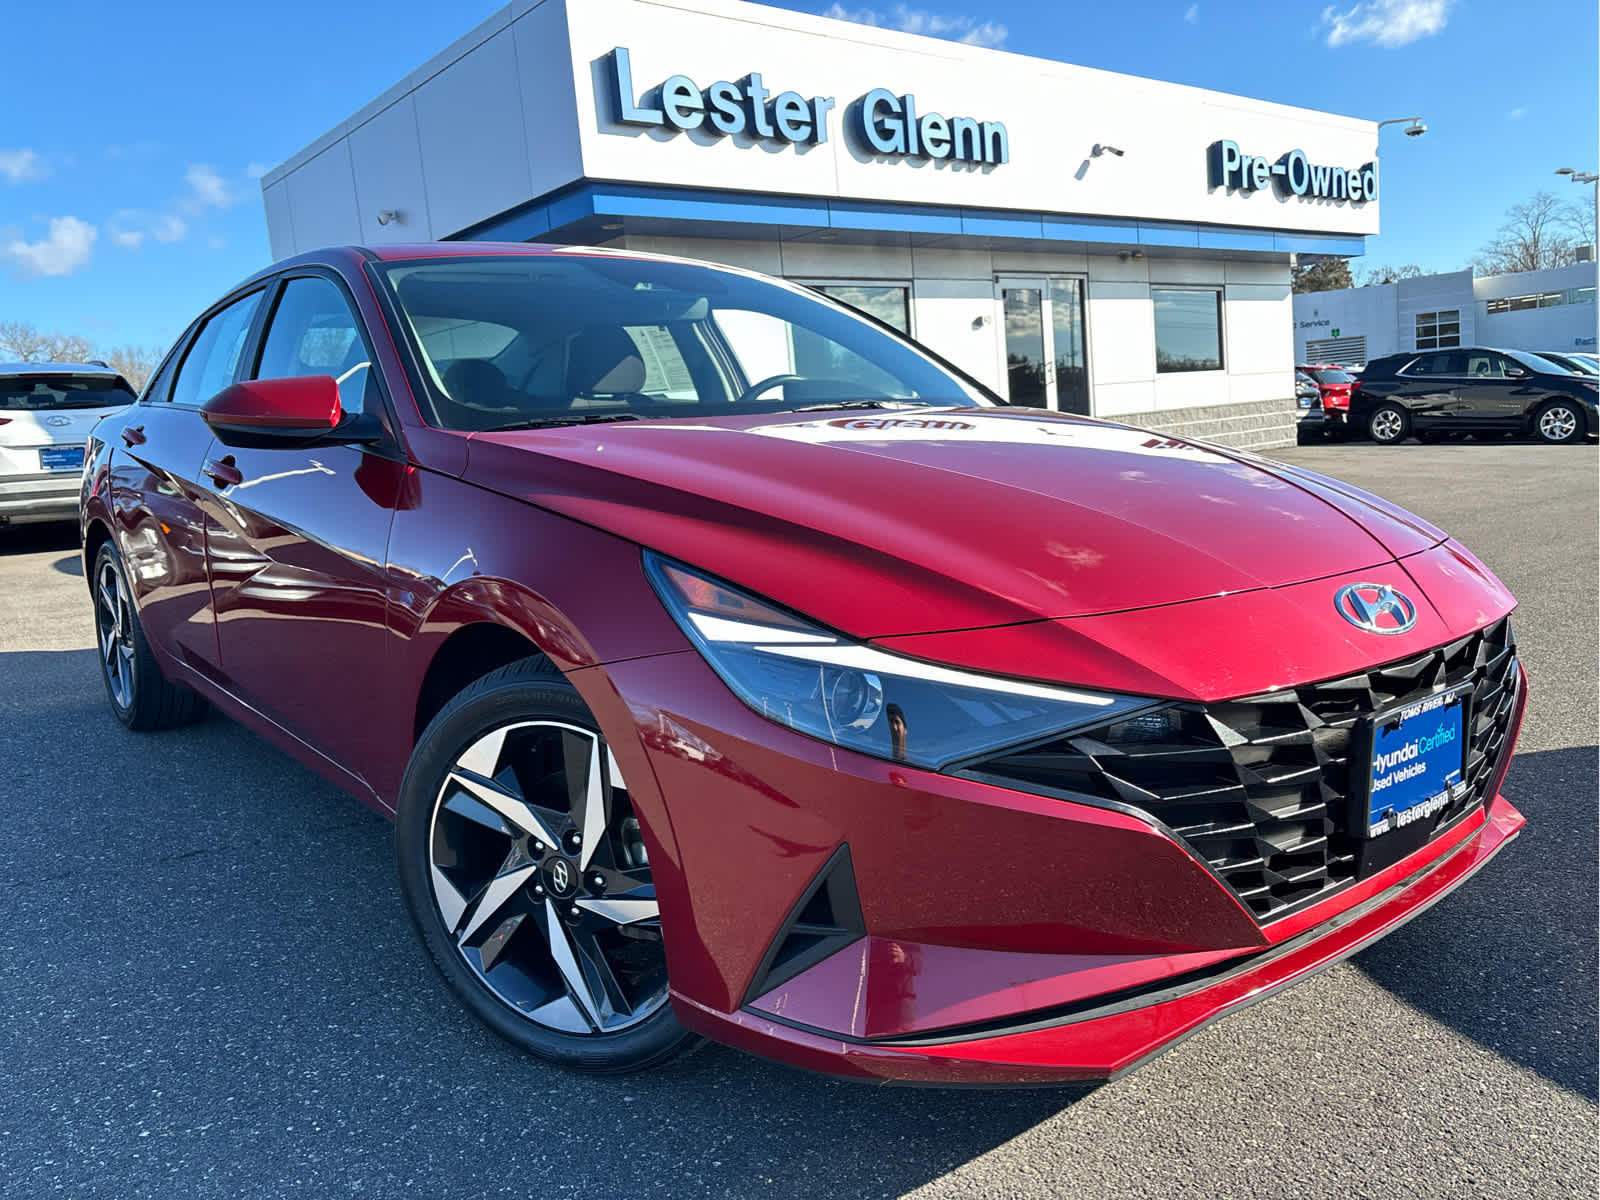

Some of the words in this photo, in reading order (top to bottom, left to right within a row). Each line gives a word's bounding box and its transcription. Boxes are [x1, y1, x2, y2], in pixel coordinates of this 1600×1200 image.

[606, 47, 835, 146] Lester
[858, 88, 1009, 164] Glenn
[1217, 139, 1377, 201] Pre-Owned
[1299, 319, 1330, 329] Service
[1400, 703, 1422, 721] TOMS
[1373, 739, 1418, 774] Hyundai
[1419, 722, 1455, 754] Certified
[1393, 762, 1426, 784] Vehicles
